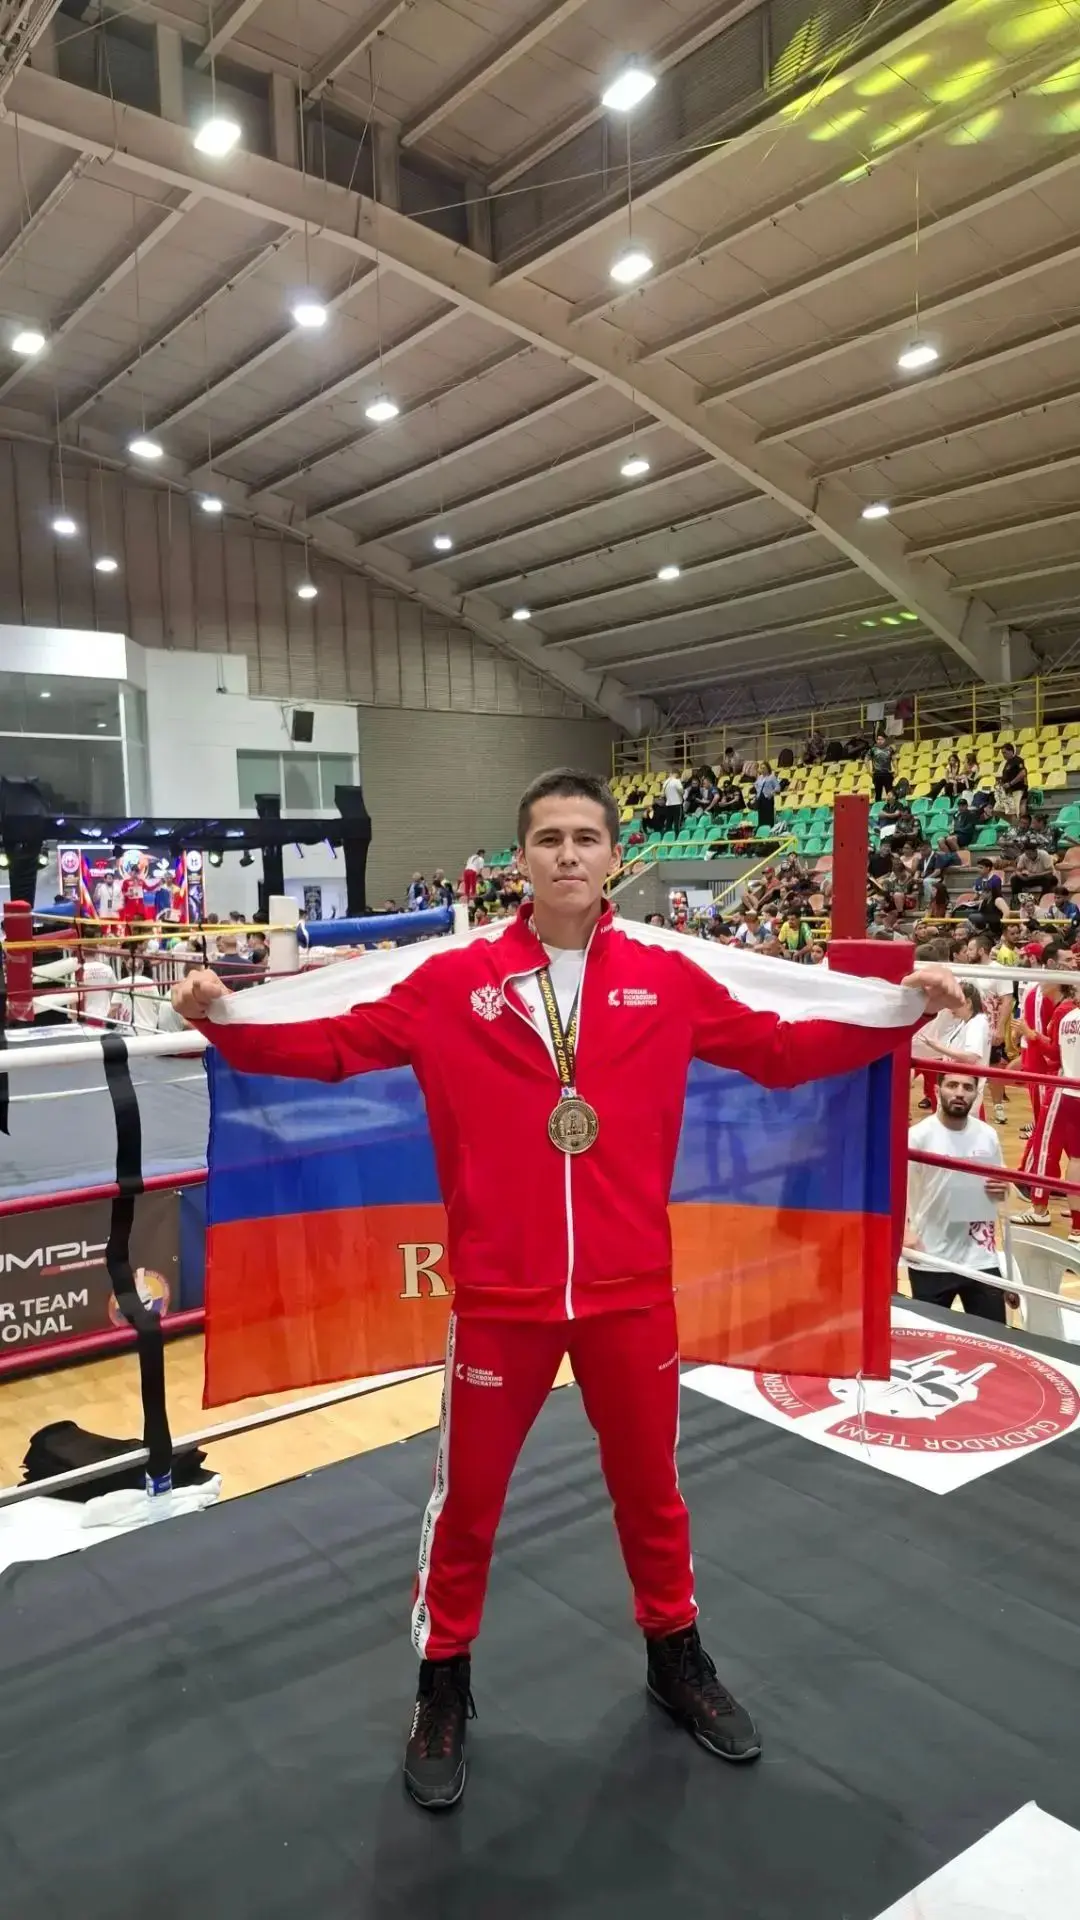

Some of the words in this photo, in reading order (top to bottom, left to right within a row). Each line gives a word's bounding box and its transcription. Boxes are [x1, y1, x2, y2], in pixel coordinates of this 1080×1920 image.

[541, 980, 563, 1047] CHAMPIONSHIP
[557, 1050, 570, 1083] WORLD
[20, 1288, 88, 1317] TEAM
[1, 1314, 73, 1343] ONAL
[836, 1424, 911, 1448] TEAM
[923, 1420, 1060, 1451] GLADIADOR
